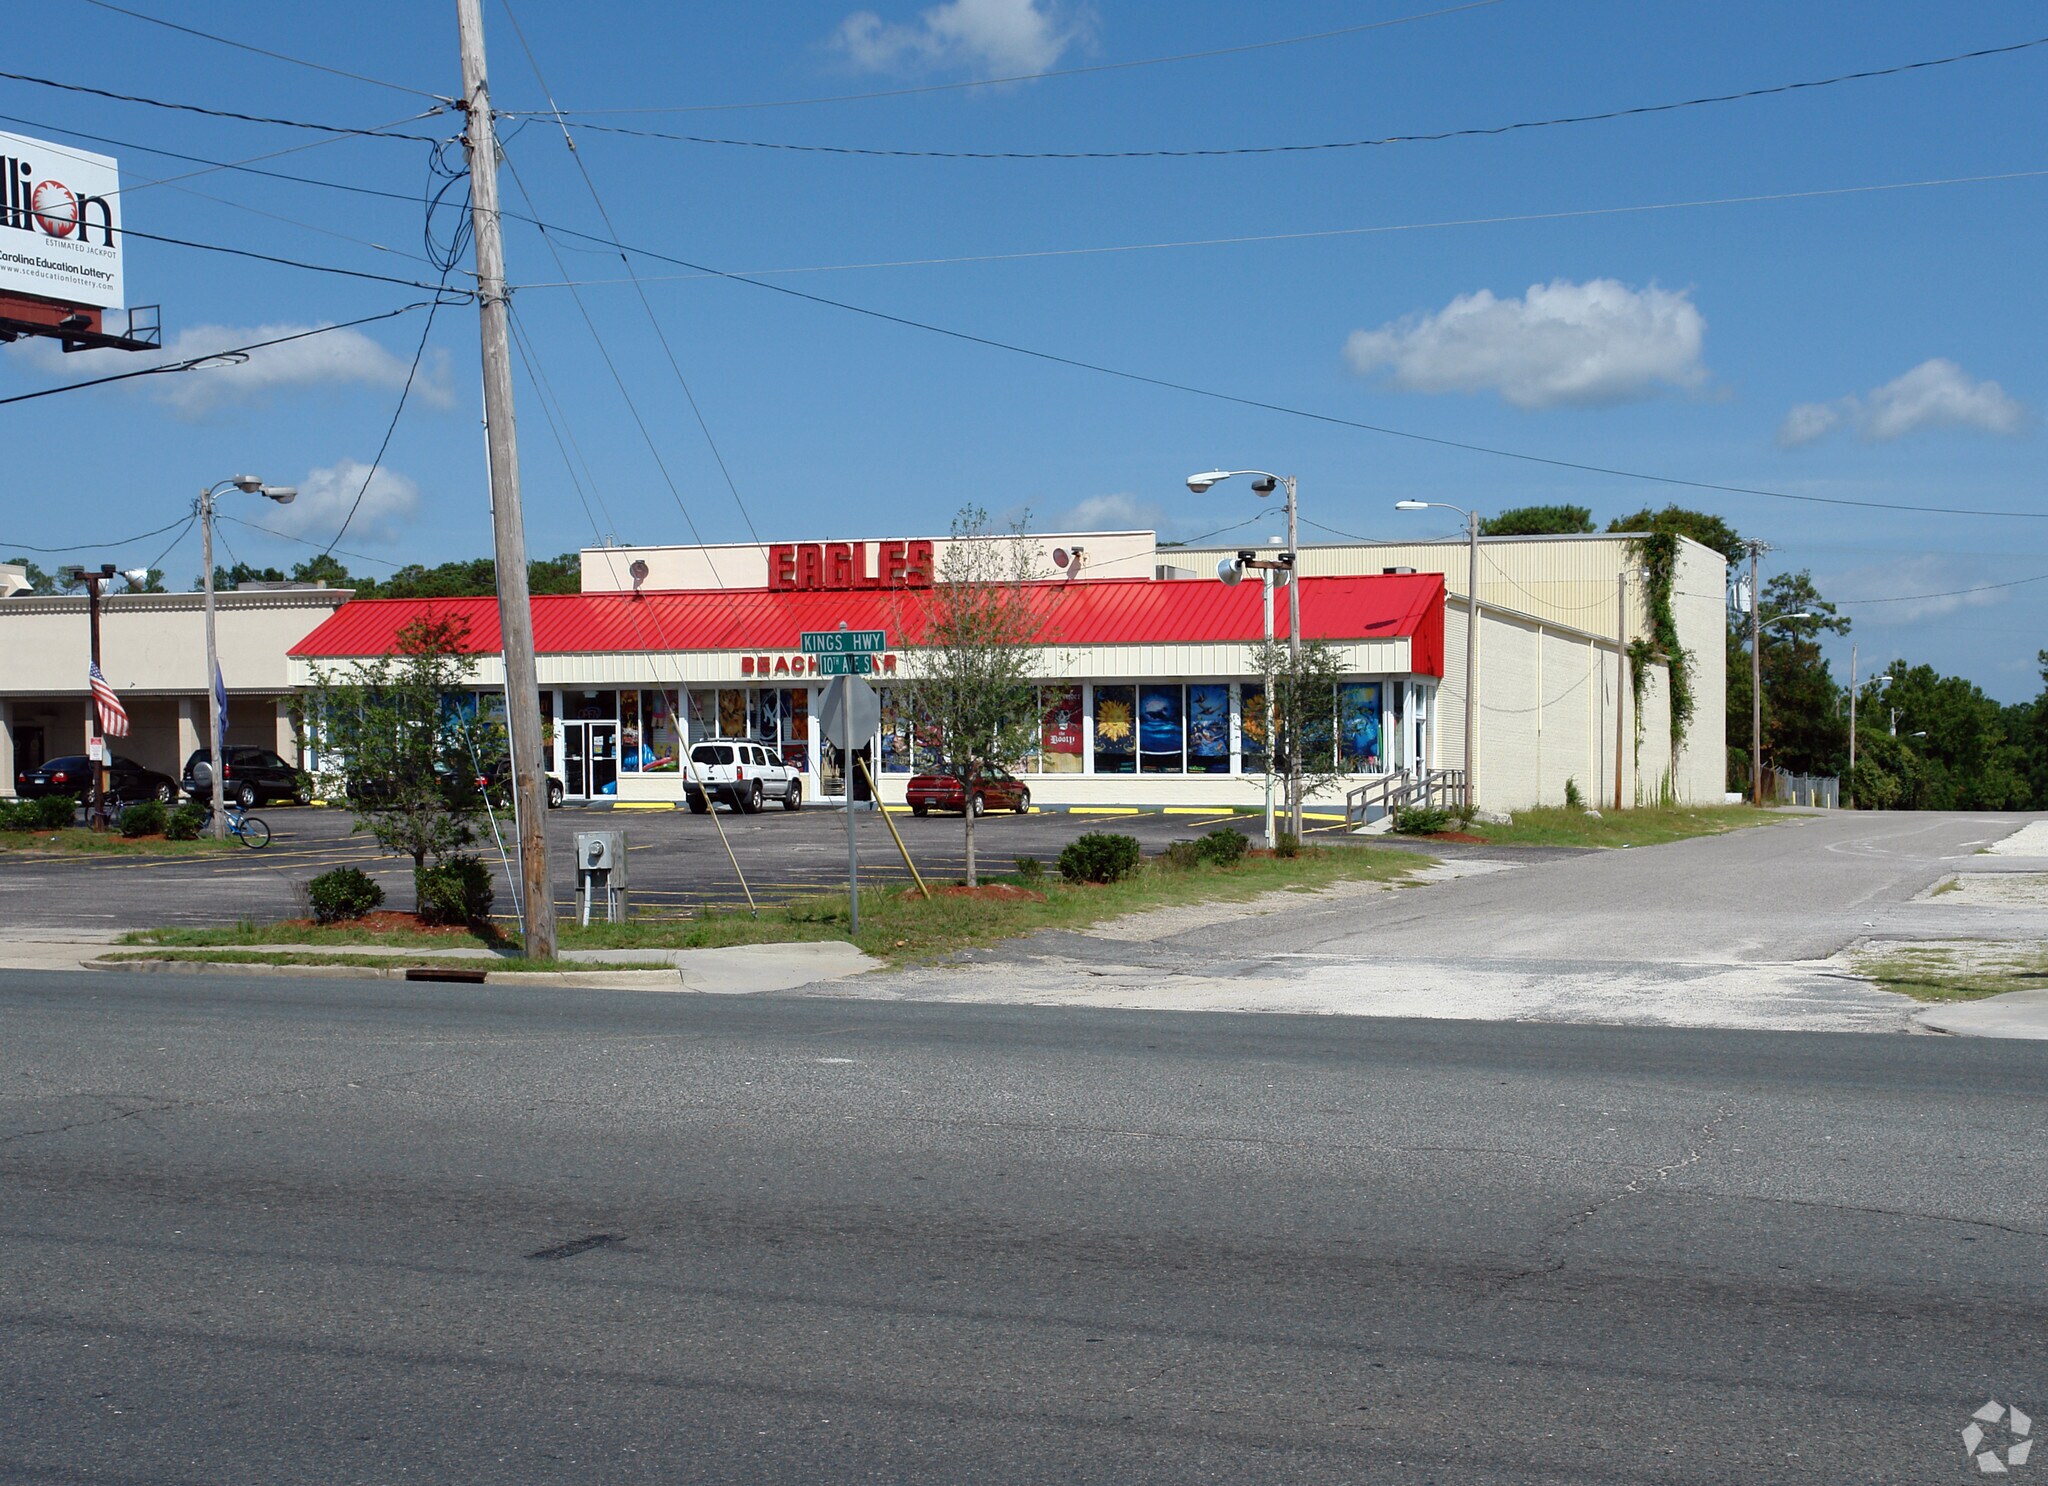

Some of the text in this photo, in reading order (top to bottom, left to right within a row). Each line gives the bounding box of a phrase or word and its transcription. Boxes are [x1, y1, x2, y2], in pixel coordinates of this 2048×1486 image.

[46, 239, 116, 259] ESTIMATED JACKPOT
[36, 257, 78, 274] Education
[0, 264, 114, 290] www.sceducationlottery.com
[769, 540, 934, 590] EAGLES
[804, 633, 880, 651] KINGS HWY
[742, 655, 817, 675] BEACH
[823, 655, 870, 673] 10TH AVE S
